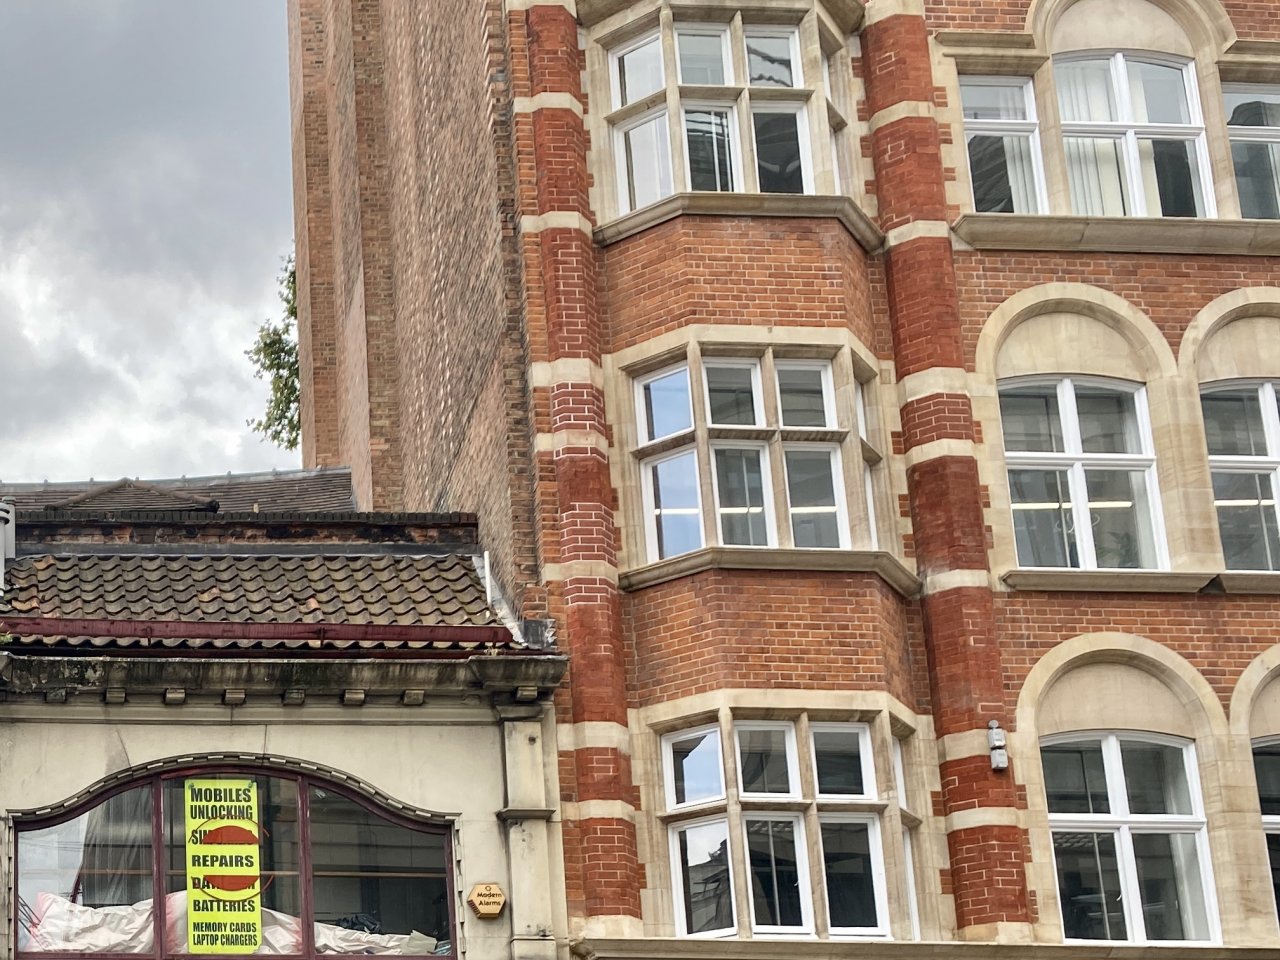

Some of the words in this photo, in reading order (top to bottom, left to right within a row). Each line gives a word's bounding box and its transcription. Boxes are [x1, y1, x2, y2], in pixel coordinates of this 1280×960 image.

[190, 787, 252, 803] MOBILES
[190, 805, 253, 820] UNLOCKING
[191, 854, 254, 868] REPAIRS
[192, 899, 256, 913] BATTERIES
[192, 921, 228, 933] MEMORY
[229, 922, 257, 933] CARDS
[192, 933, 220, 946] LAPTOP
[220, 933, 258, 947] CHARGERS
